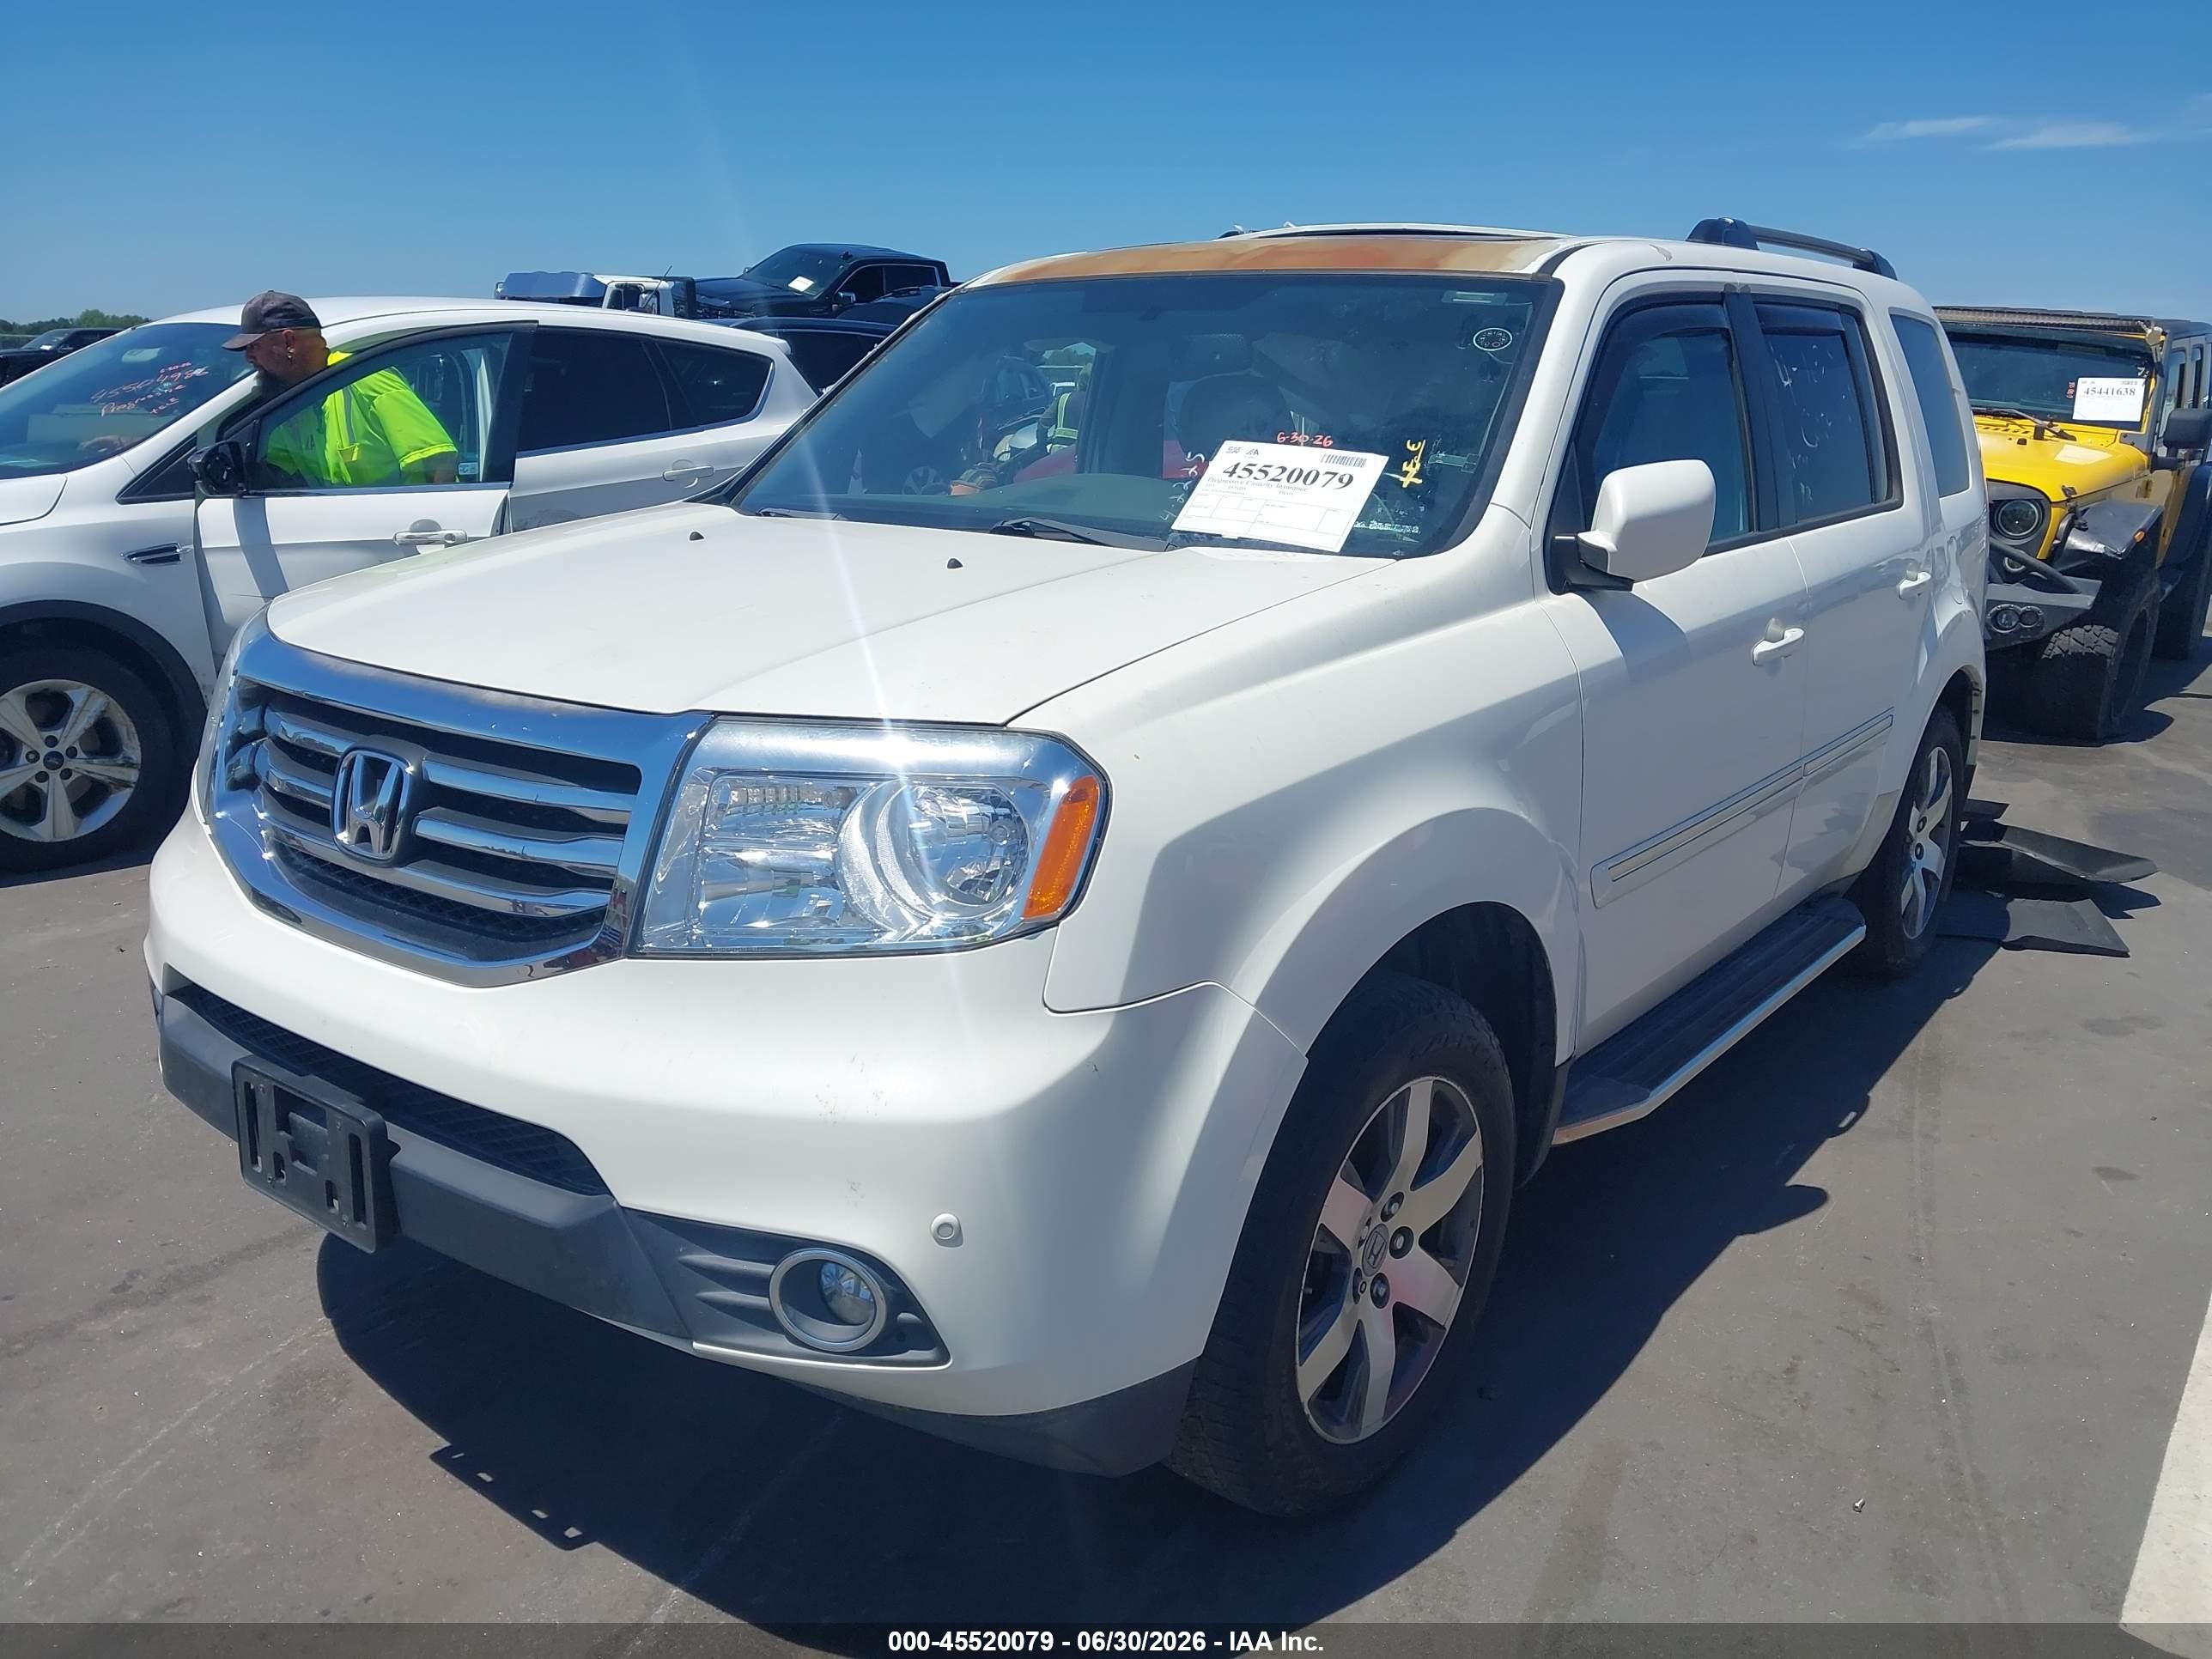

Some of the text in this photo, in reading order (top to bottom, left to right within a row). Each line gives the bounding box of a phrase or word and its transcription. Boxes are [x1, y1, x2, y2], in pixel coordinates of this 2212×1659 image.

[2083, 386, 2136, 397] 45441638
[1276, 431, 1334, 447] 6-30-26
[1222, 462, 1354, 490] 45520079
